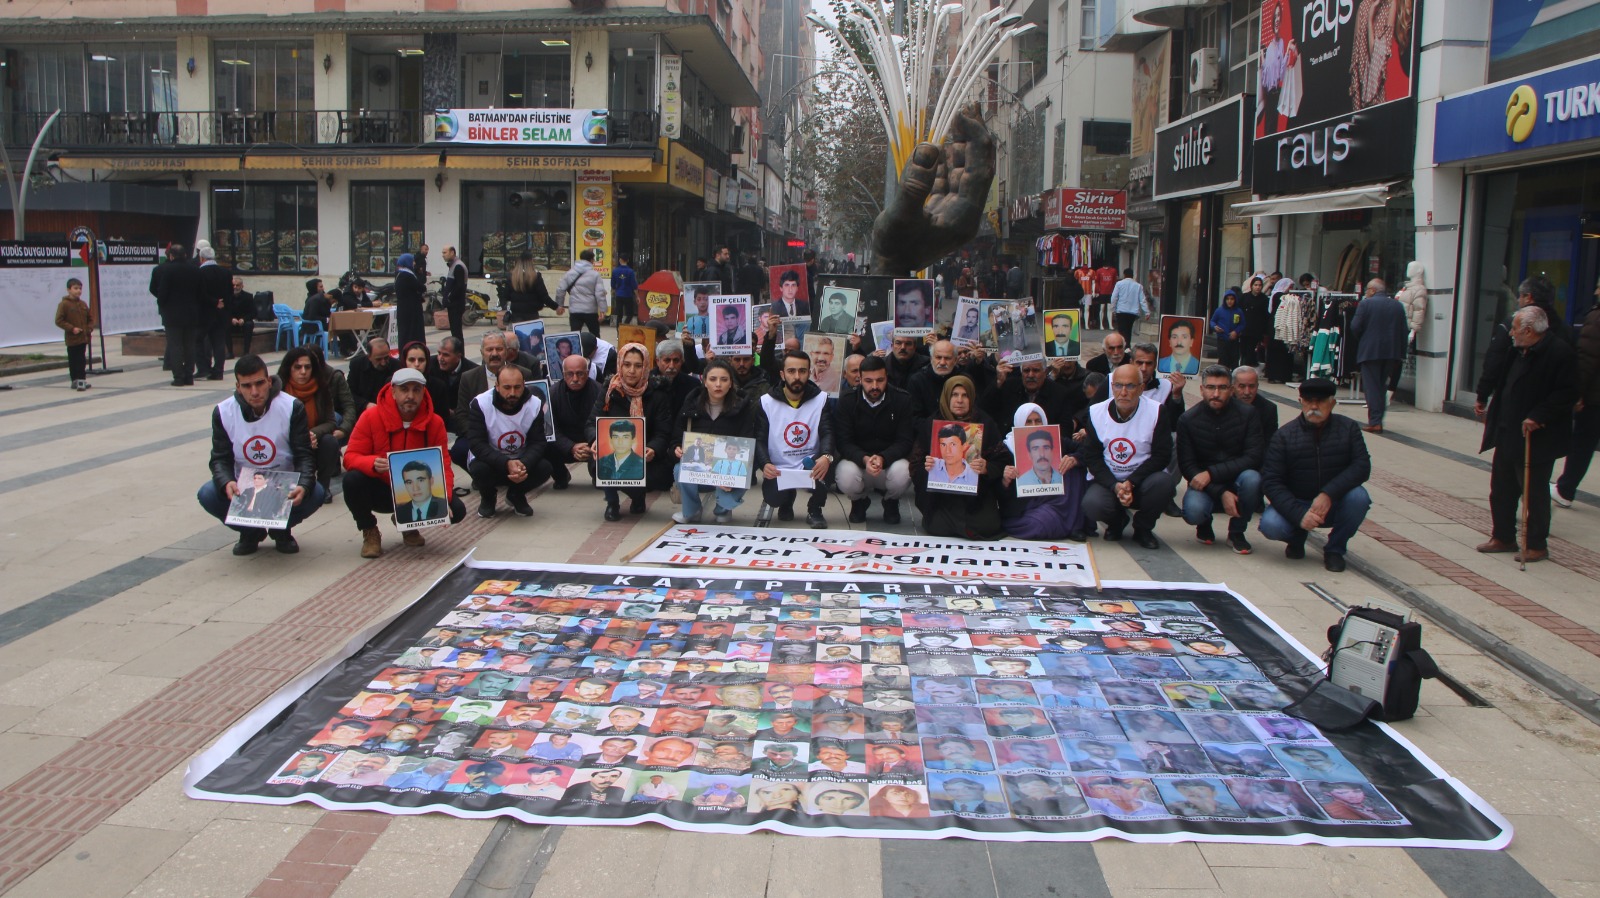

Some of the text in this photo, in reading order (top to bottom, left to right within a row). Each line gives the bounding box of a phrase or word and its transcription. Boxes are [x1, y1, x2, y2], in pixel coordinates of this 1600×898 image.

[469, 112, 571, 124] BATMAN'DAN FİLİSTİNE
[468, 124, 572, 141] BİNLER SELAM
[1173, 123, 1211, 172] stilife
[1276, 121, 1350, 177] rays
[302, 156, 381, 167] ŞEHİR SOFRASI
[506, 157, 591, 168] ŞEHİR SOFRASI
[1074, 192, 1114, 206] Şirin
[1065, 205, 1122, 215] Collection
[24, 246, 45, 257] DUYGU
[46, 246, 68, 257] DUVARI
[728, 296, 748, 305] ÇELİK
[655, 540, 801, 557] Failler
[865, 537, 1029, 553] Bulunsun
